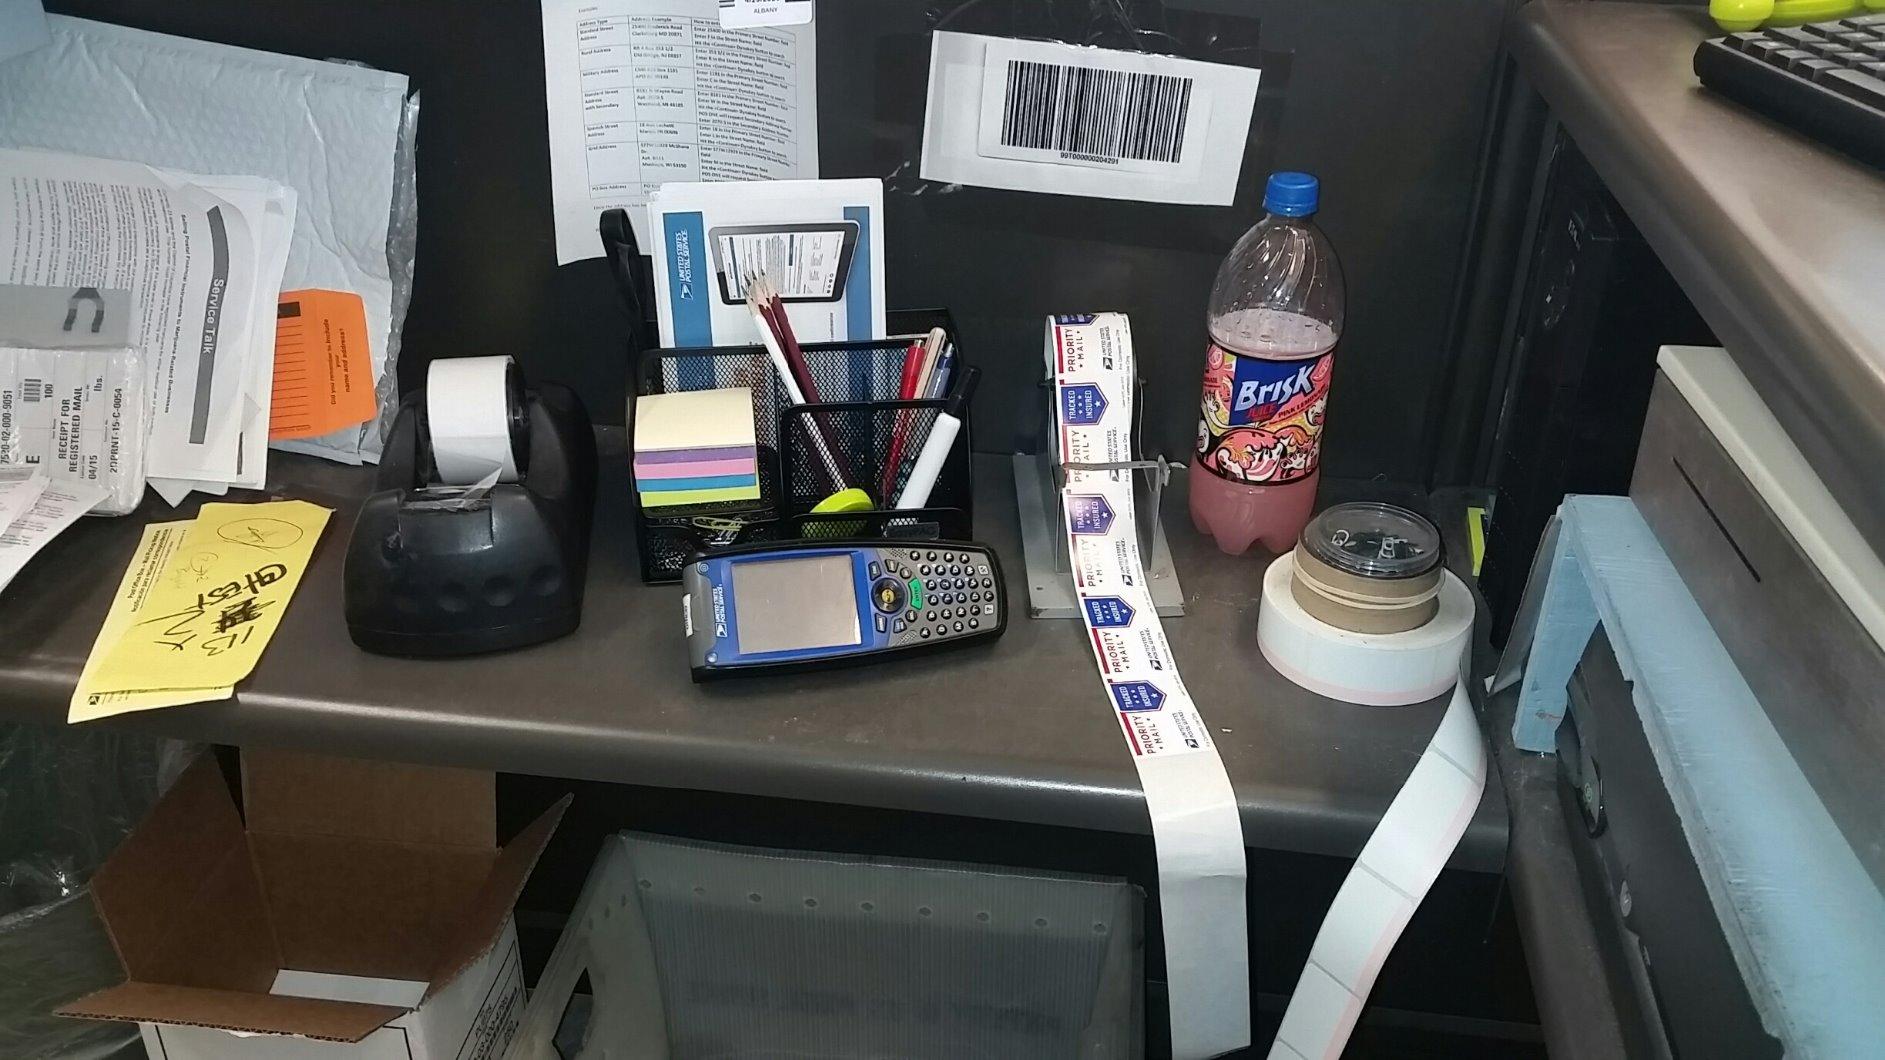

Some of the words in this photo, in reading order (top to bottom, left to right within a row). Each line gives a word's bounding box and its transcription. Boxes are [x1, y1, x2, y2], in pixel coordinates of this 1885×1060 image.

[181, 214, 190, 234] Selling
[681, 229, 689, 257] SERVICE
[182, 256, 191, 282] Financial
[677, 255, 685, 281] UNITED
[176, 283, 187, 318] Instruments
[206, 278, 226, 326] Service
[202, 328, 214, 354] Talk
[323, 318, 331, 344] include
[1065, 328, 1076, 373] PRIORITY
[1076, 336, 1084, 360] MAIL
[342, 359, 350, 372] and
[44, 384, 54, 398] 100
[94, 375, 103, 392] lbs.
[164, 379, 174, 414] Businesses
[61, 398, 70, 417] FOR
[1068, 390, 1076, 419] TRACKED
[1278, 407, 1296, 418] PINK
[58, 420, 69, 460] RECEIPT
[69, 414, 81, 472] REGISTERED
[26, 455, 40, 464] E
[88, 454, 98, 480] 04/15
[1072, 430, 1082, 482] PRORITY
[1092, 501, 1101, 529] INSURED
[1092, 602, 1105, 623] TRACKED
[1109, 601, 1122, 622] INSURED
[1103, 631, 1122, 673] PRIORITY
[1120, 641, 1130, 664] MAIL
[1119, 686, 1133, 708] TRACKED
[1138, 686, 1152, 706] INSURED
[1132, 716, 1156, 754] PRIORITY
[1152, 723, 1163, 745] MAIL
